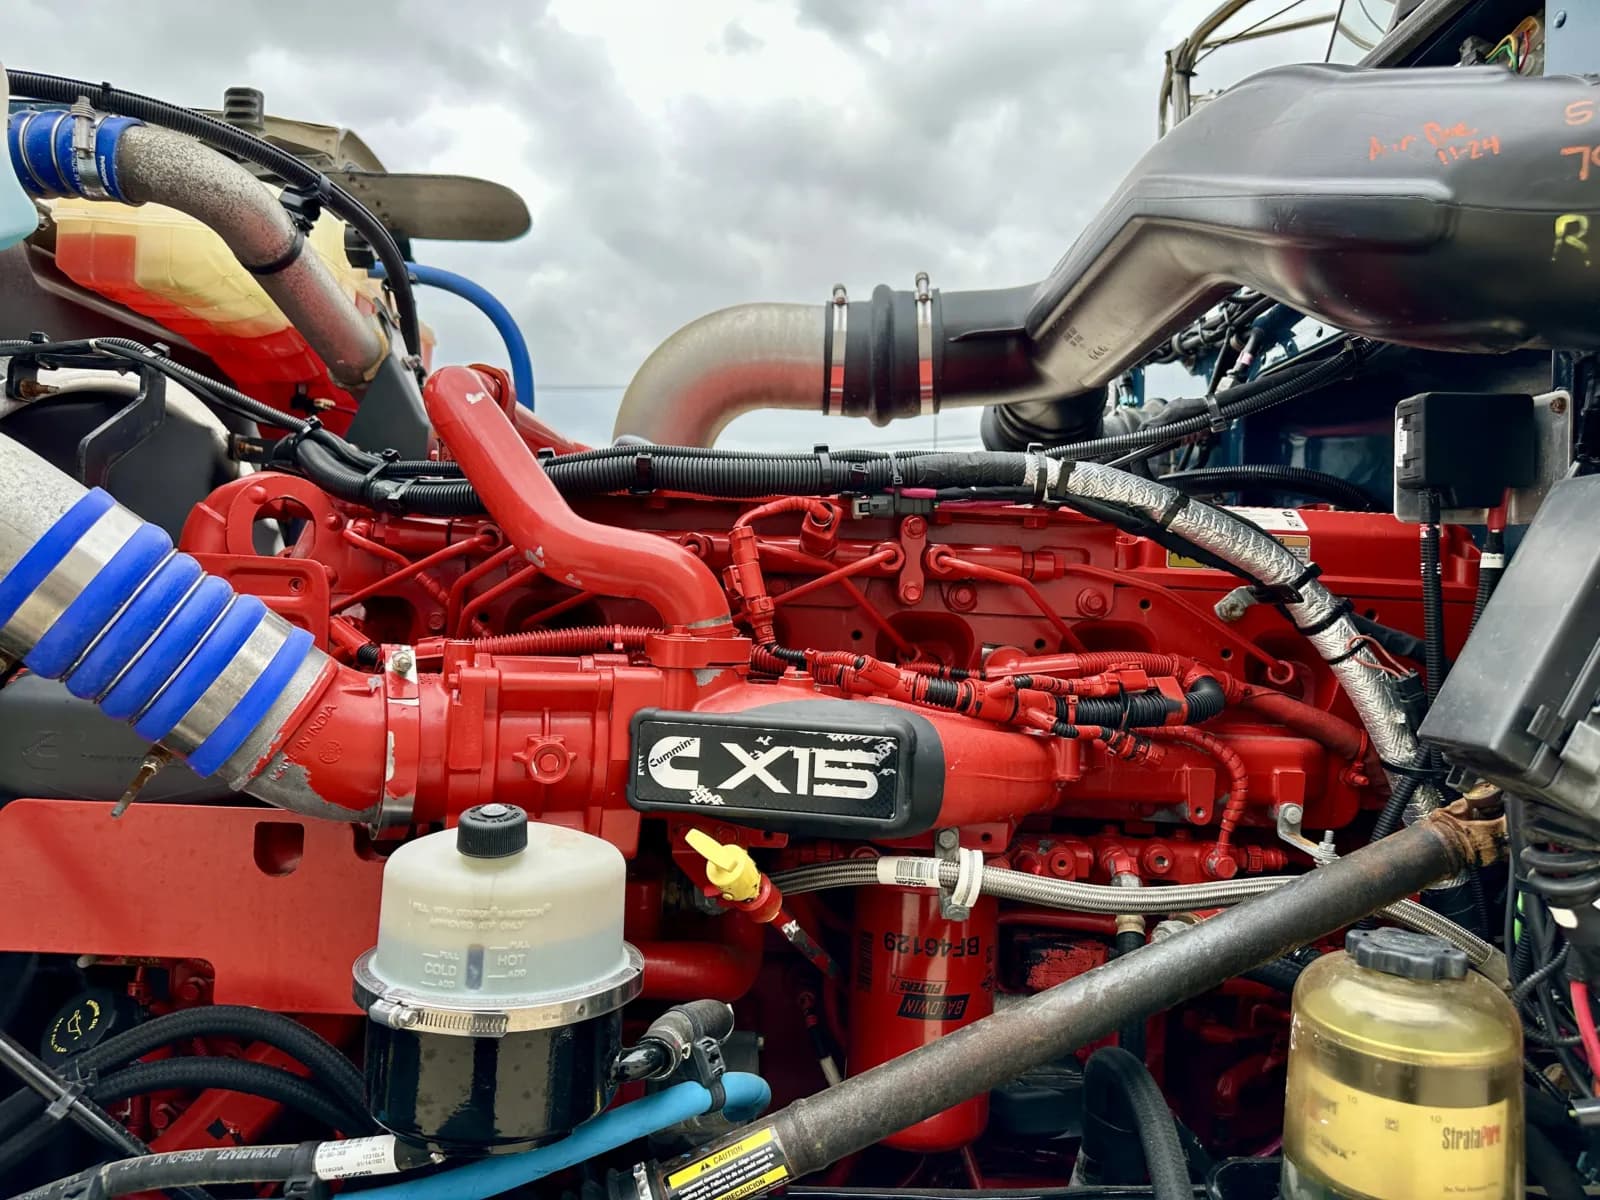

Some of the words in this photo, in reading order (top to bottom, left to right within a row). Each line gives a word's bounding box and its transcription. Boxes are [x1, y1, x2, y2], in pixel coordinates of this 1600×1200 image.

[1553, 213, 1590, 256] R
[296, 737, 311, 752] IN
[306, 704, 337, 736] INDIA
[716, 742, 879, 800] X15
[884, 932, 980, 957] BF46129
[497, 954, 526, 966] HOT
[424, 962, 457, 976] COLD
[508, 969, 527, 977] ADD
[438, 980, 456, 988] ADD
[900, 981, 943, 994] FILTERS
[903, 999, 966, 1016] BALDWIN
[712, 1144, 744, 1164] CAUTION
